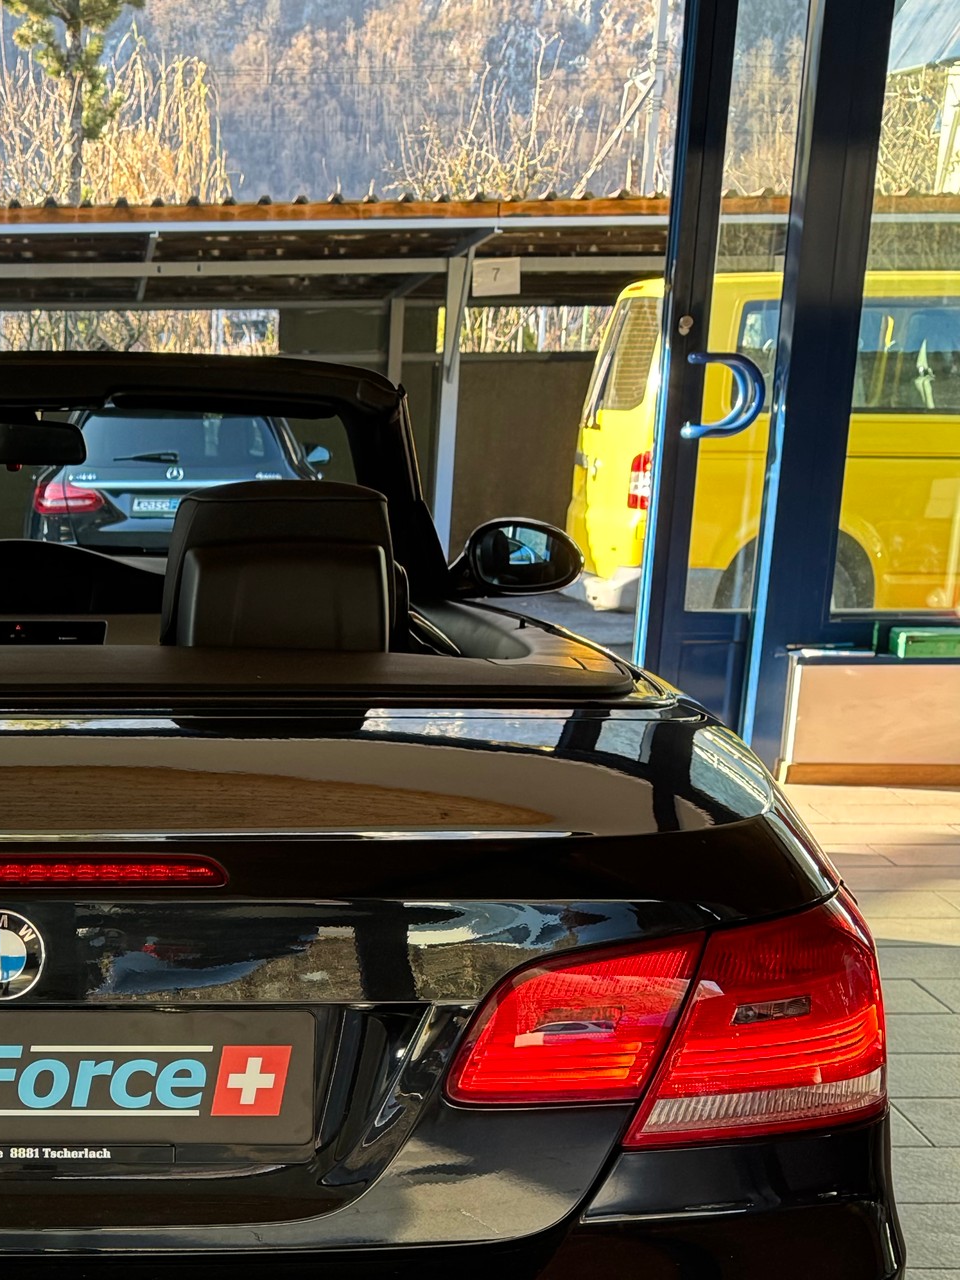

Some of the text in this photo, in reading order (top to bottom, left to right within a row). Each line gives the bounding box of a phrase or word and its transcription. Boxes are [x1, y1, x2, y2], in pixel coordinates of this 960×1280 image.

[491, 267, 501, 283] 7
[132, 497, 180, 512] LeaseF
[9, 1147, 40, 1159] 8881
[42, 1147, 111, 1159] Tscherlach
